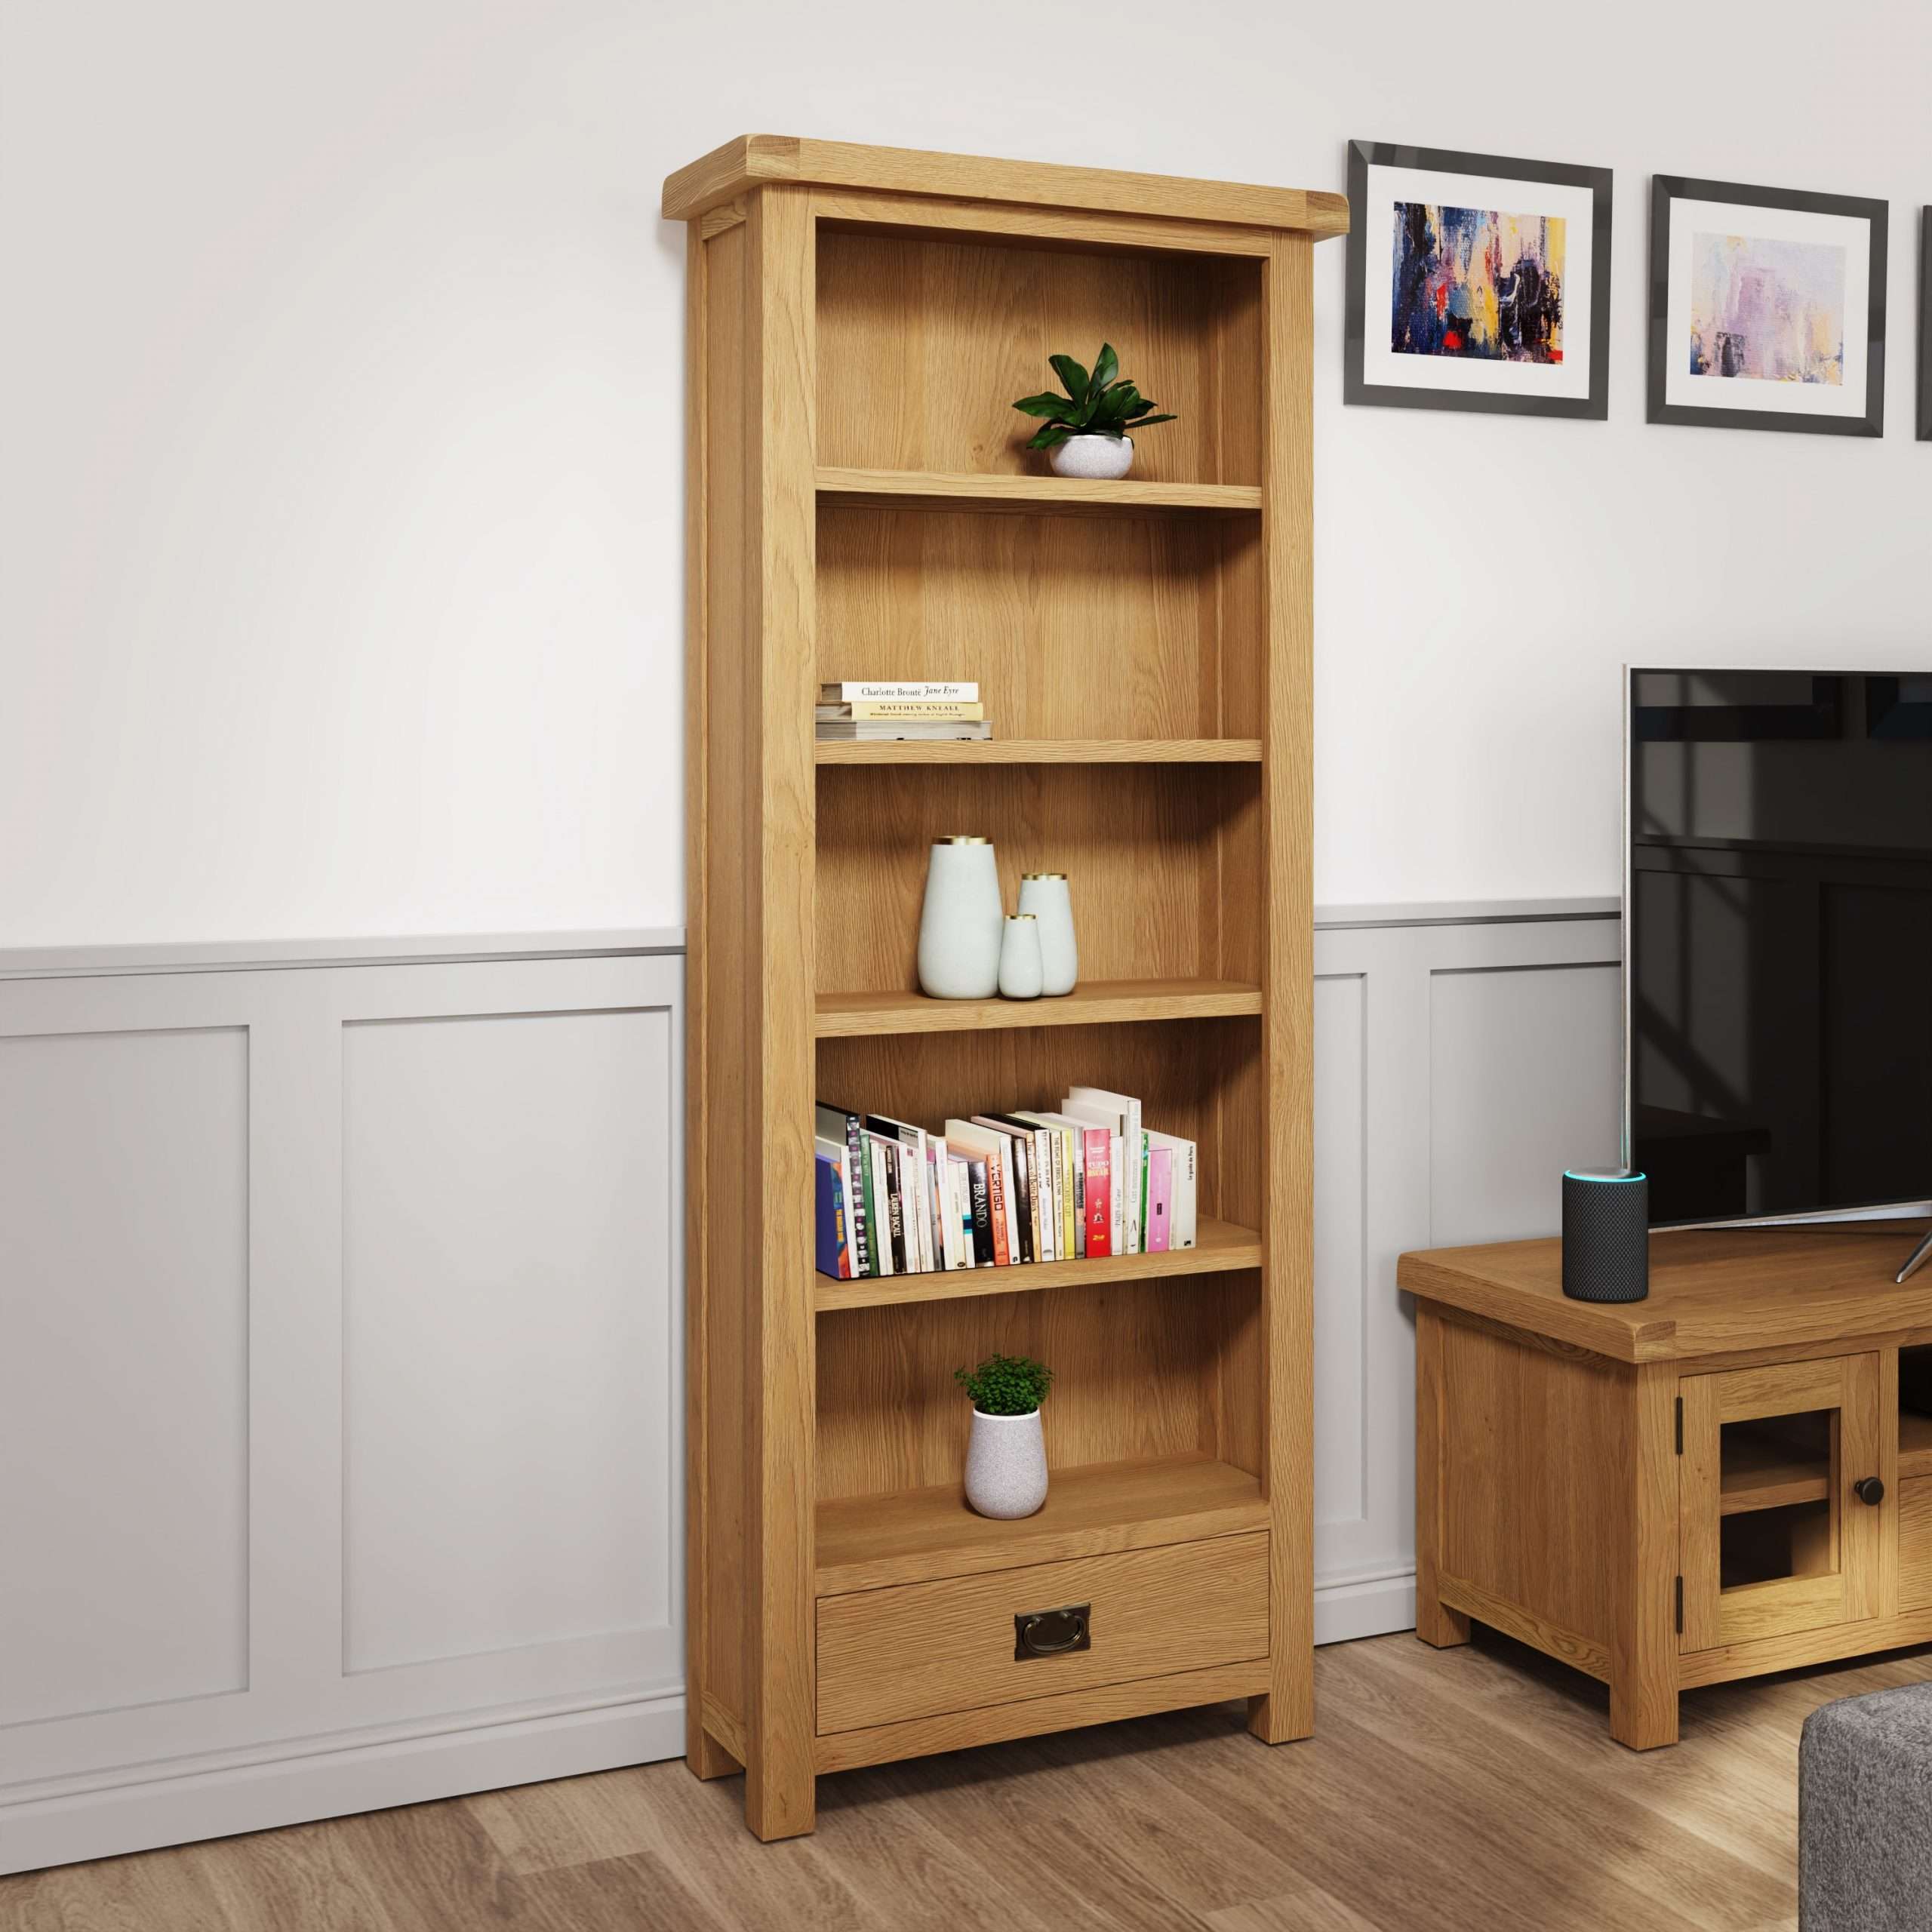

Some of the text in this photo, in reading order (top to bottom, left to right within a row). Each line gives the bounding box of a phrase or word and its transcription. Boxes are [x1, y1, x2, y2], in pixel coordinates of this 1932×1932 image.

[861, 687, 895, 697] Charlotte
[923, 685, 941, 697] Jane
[943, 685, 959, 697] Eyre
[990, 1163, 1003, 1211] VERTIGO
[890, 1192, 900, 1215] LAUREN
[973, 1183, 987, 1228] BRANDO
[891, 1216, 901, 1238] BACALL
